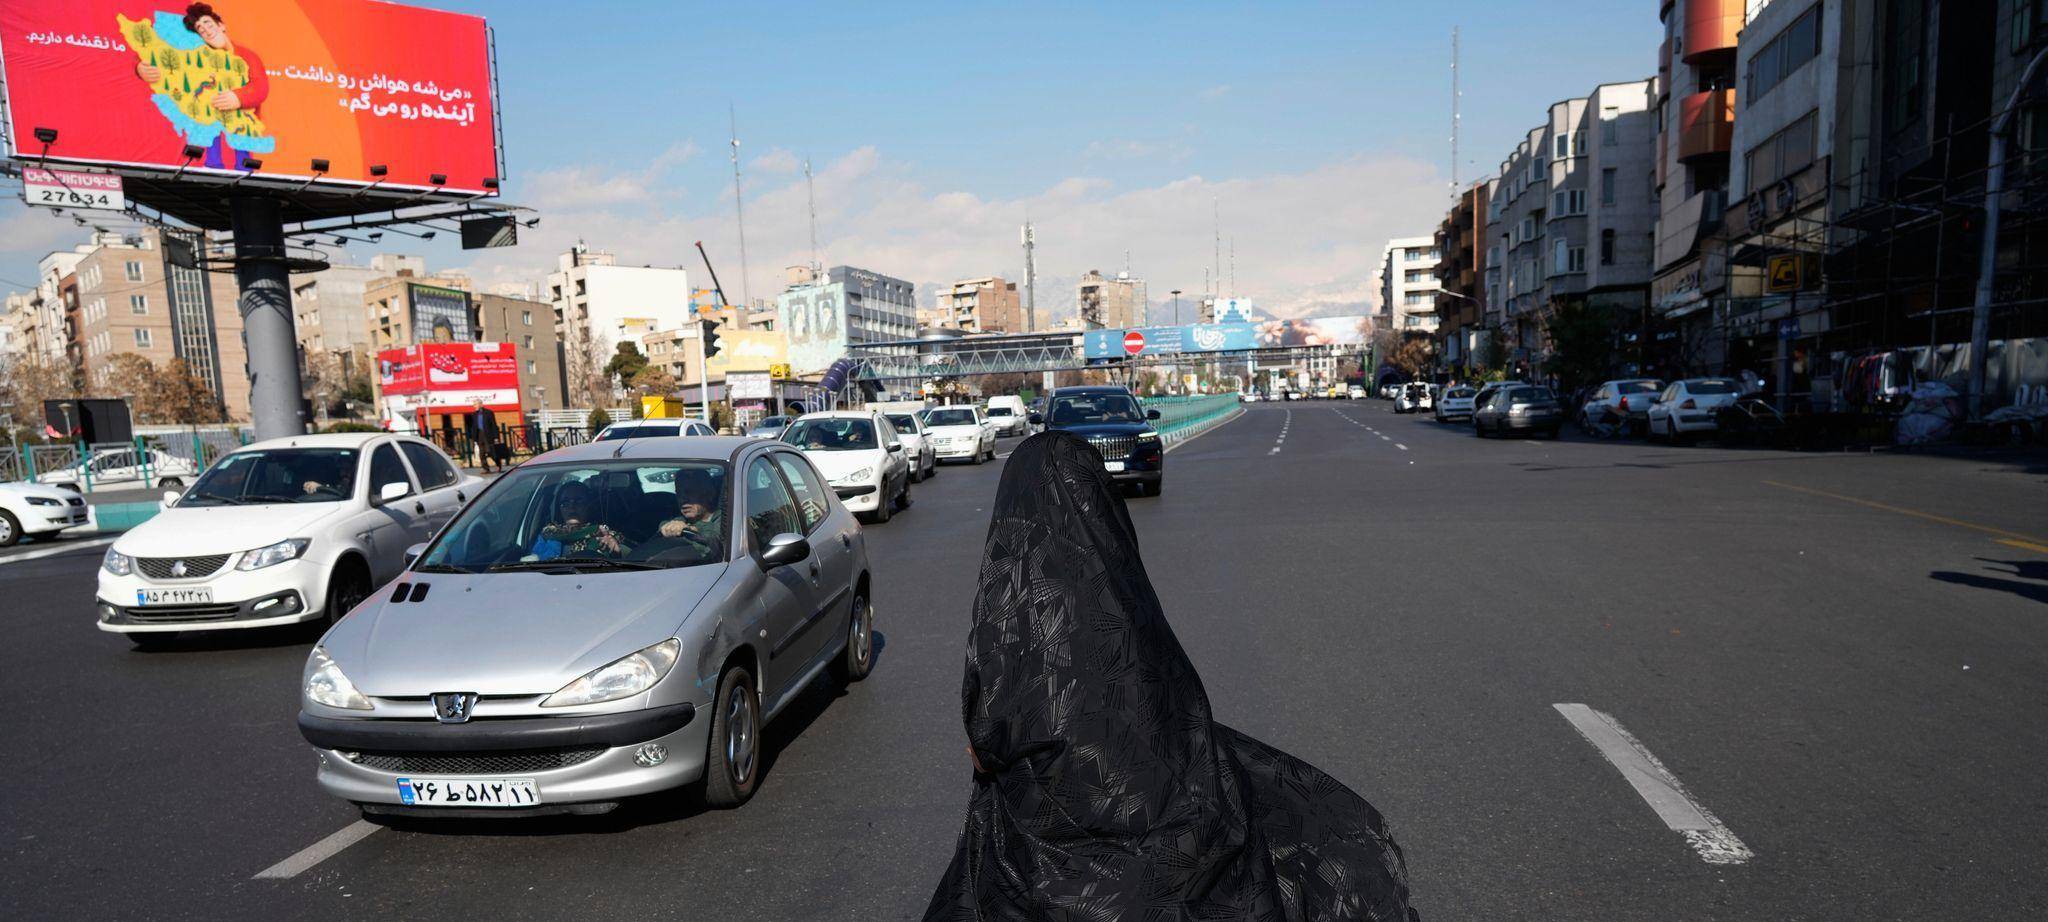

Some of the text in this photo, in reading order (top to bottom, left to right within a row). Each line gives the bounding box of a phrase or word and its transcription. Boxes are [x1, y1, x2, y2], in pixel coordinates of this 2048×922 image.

[26, 31, 126, 52] ما نقشه داریم.
[284, 65, 335, 83] داشت
[337, 71, 356, 90] رو
[359, 74, 410, 95] هواش
[400, 103, 419, 120] رو
[421, 102, 475, 127] آینده
